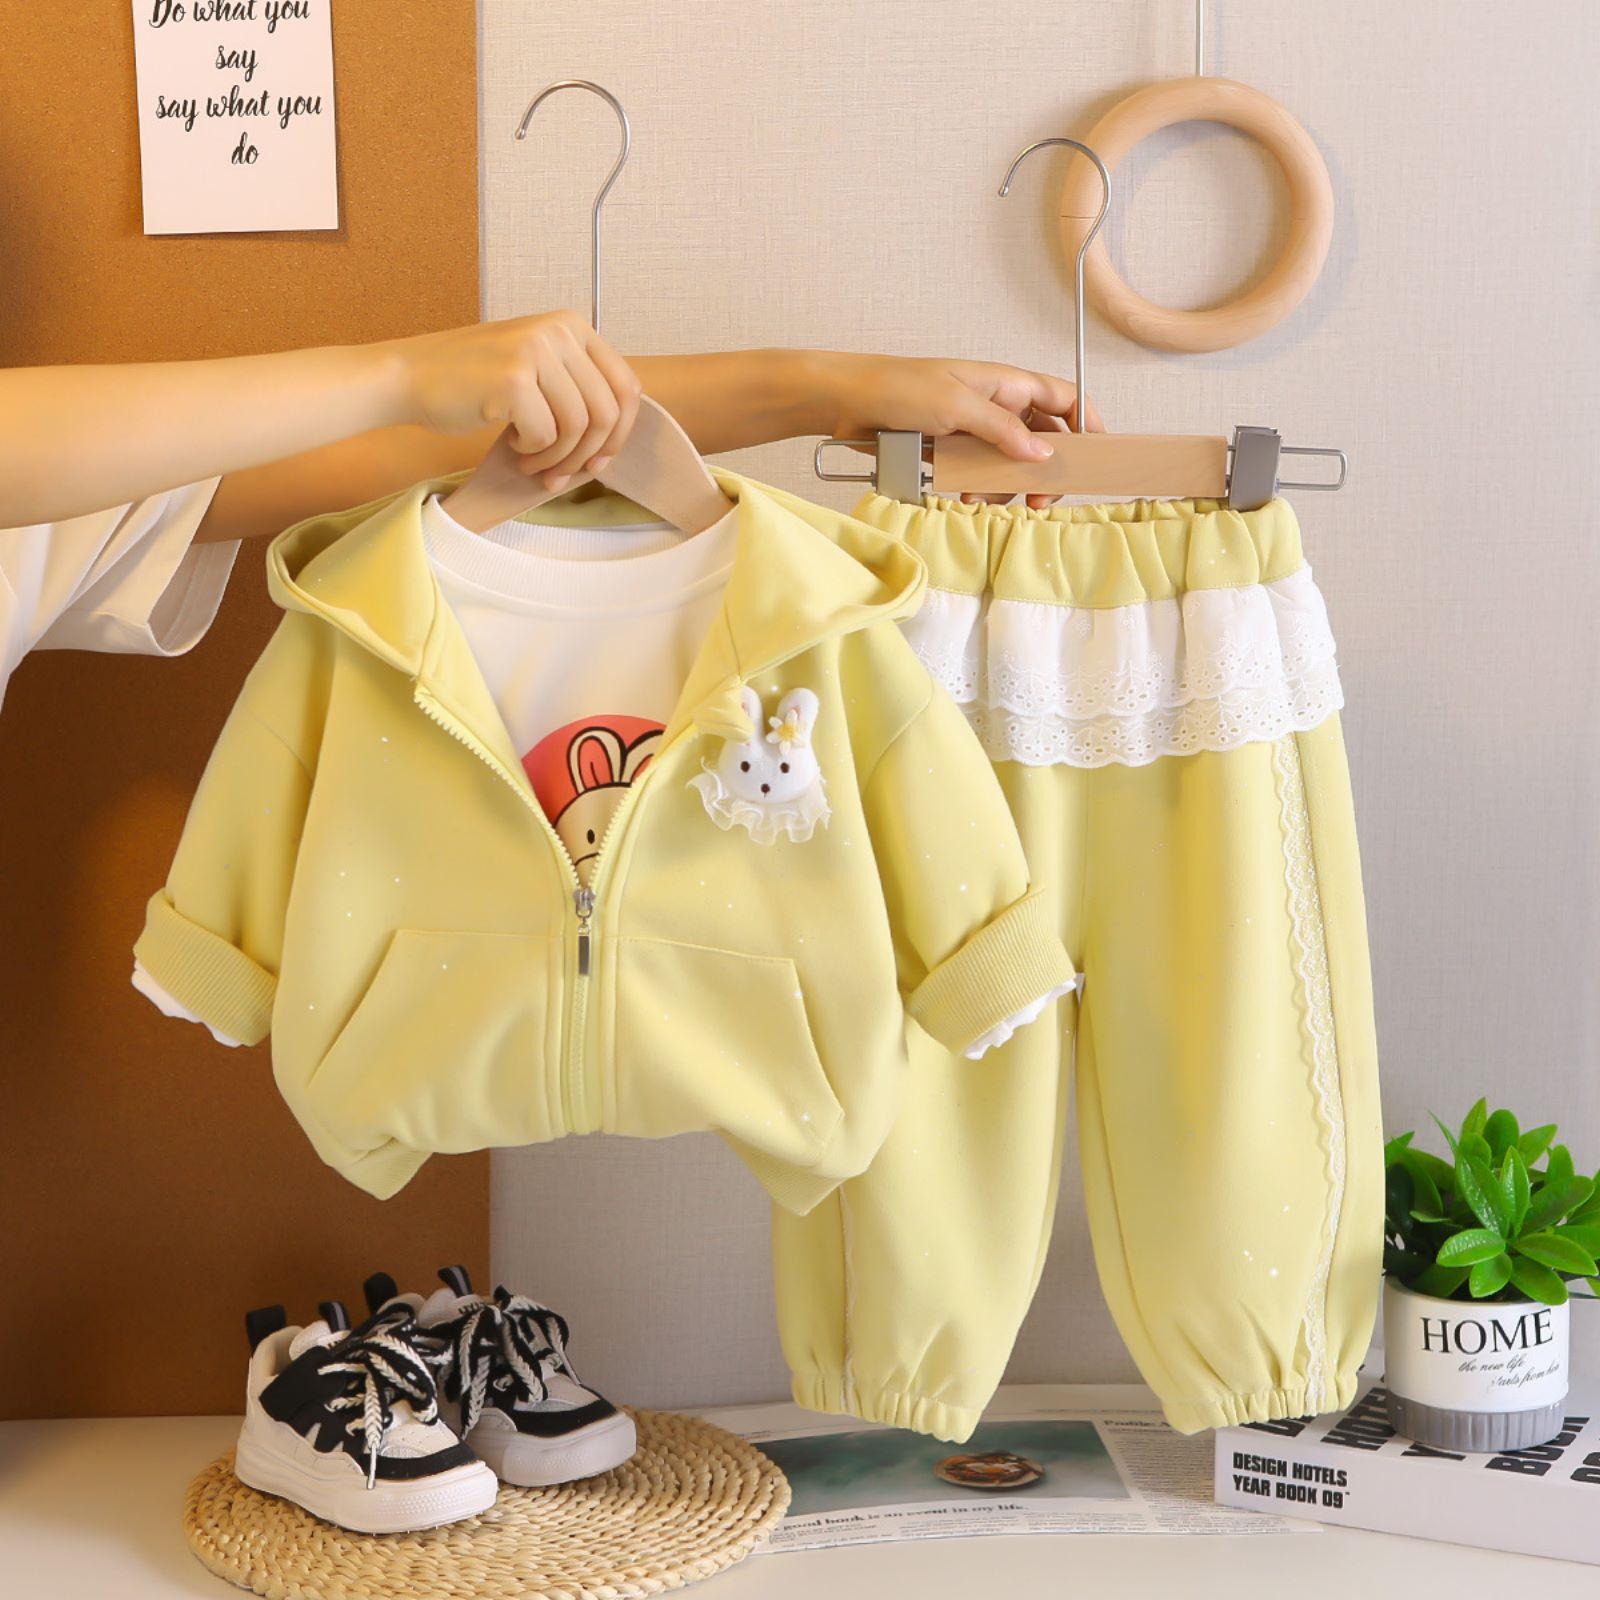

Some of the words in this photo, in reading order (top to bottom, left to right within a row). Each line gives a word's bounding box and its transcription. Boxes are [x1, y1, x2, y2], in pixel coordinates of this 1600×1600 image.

[148, 0, 186, 28] Do
[193, 0, 258, 21] what
[264, 0, 310, 33] you
[215, 45, 259, 82] say
[156, 95, 199, 132] say
[206, 85, 270, 117] what
[277, 96, 322, 129] you
[231, 131, 259, 164] do
[1420, 1308, 1554, 1355] HOME
[1458, 1359, 1477, 1372] the
[1480, 1362, 1504, 1371] new
[1233, 1452, 1287, 1477] DESIGN
[1292, 1462, 1347, 1487] HOTELS
[1232, 1474, 1270, 1496] YEAR
[1276, 1482, 1317, 1504] BOOK
